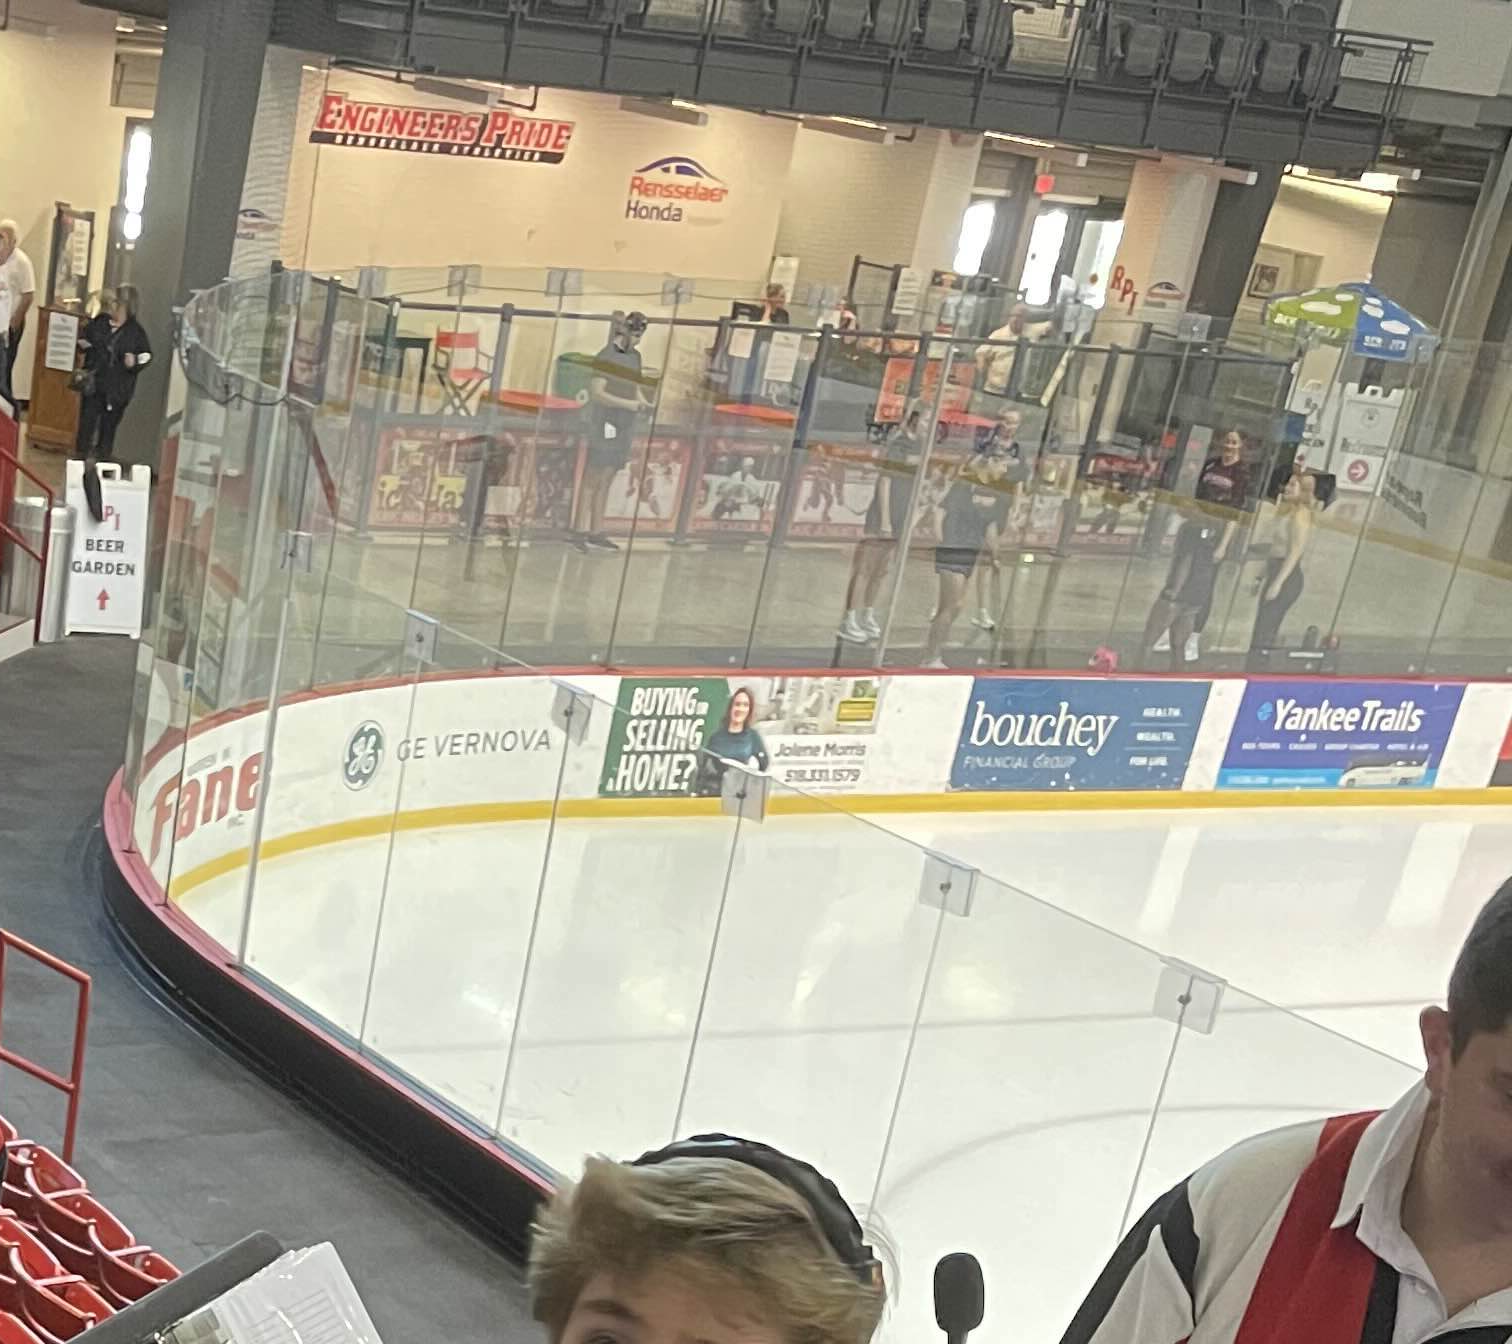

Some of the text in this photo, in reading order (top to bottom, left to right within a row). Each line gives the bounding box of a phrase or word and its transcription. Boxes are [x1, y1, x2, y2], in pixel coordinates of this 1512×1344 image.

[317, 94, 573, 150] ENGINEERS PRIDE
[629, 175, 729, 203] Rensselaer
[625, 199, 684, 222] Honda
[1110, 264, 1139, 316] RPI
[85, 538, 125, 554] BEER
[71, 560, 136, 577] GARDEN
[630, 686, 699, 717] BUYING
[623, 718, 705, 753] SELLING
[969, 700, 1120, 757] bouchey
[396, 728, 552, 762] GE VERNOVA
[614, 753, 699, 792] HOME?
[962, 754, 1077, 769] FINANCIAL GROUP
